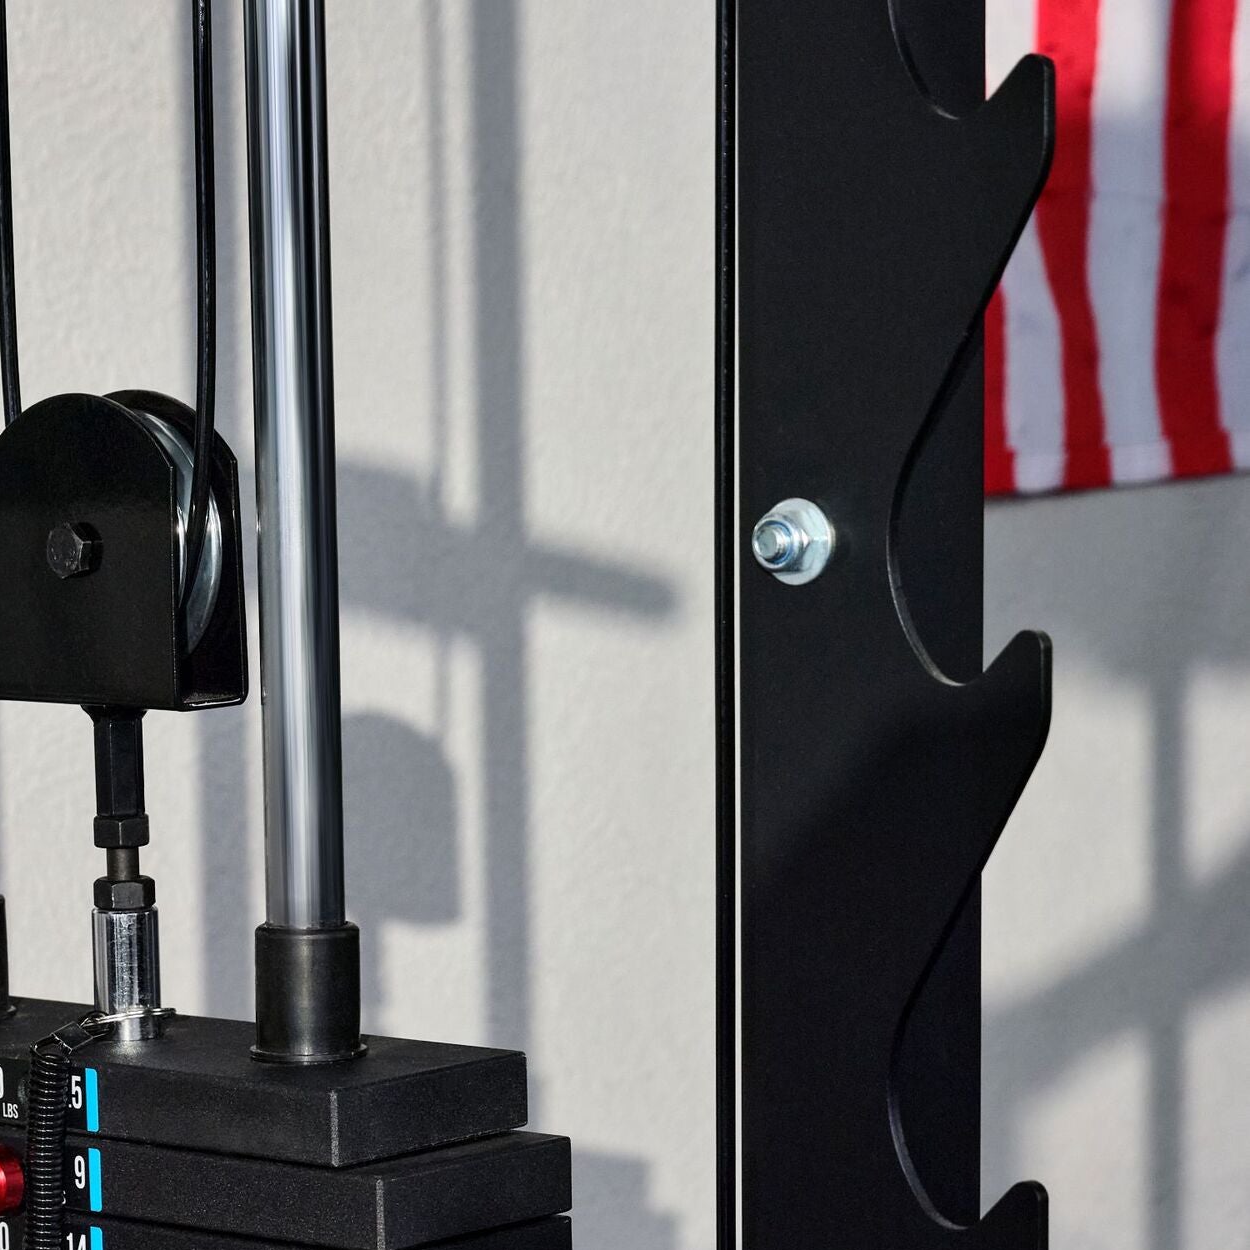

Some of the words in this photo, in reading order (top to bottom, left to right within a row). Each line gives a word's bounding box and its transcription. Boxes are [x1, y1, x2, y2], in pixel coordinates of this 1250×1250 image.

[69, 1076, 82, 1109] .5
[3, 1103, 18, 1118] LBS
[75, 1156, 85, 1188] 9
